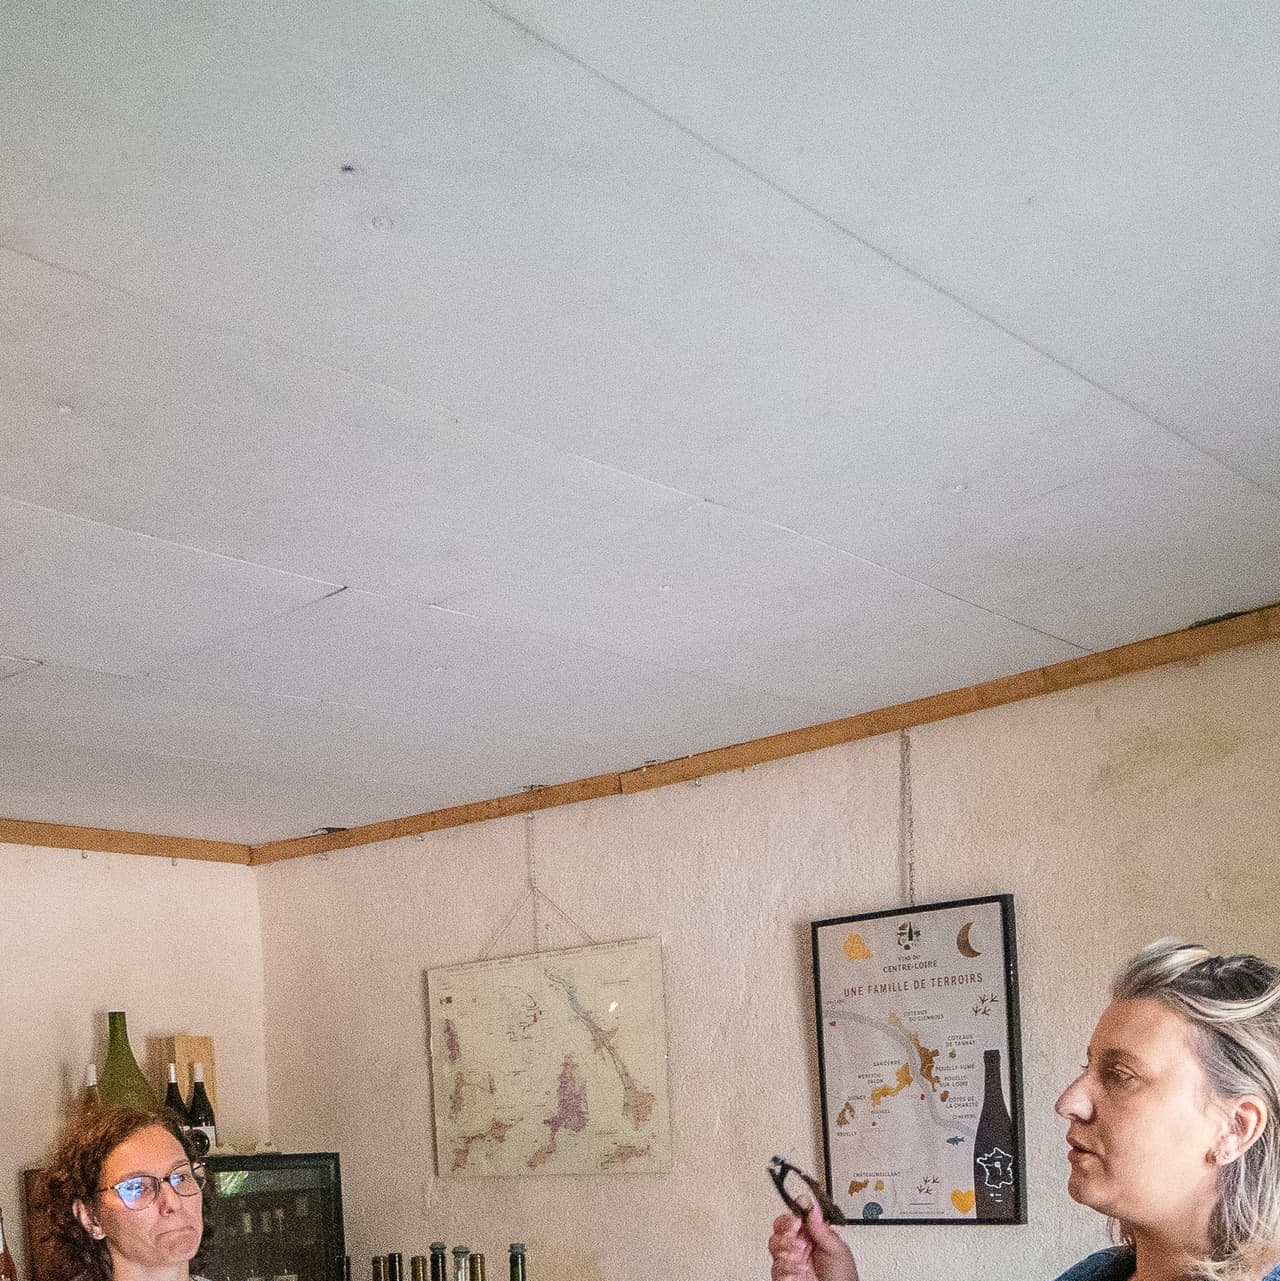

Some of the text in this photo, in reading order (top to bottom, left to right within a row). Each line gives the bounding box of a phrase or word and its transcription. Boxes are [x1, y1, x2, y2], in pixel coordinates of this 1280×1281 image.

[882, 960, 938, 974] CENTRE-LOIRE
[843, 971, 984, 998] UNE FAMILLE DE TERROIRS
